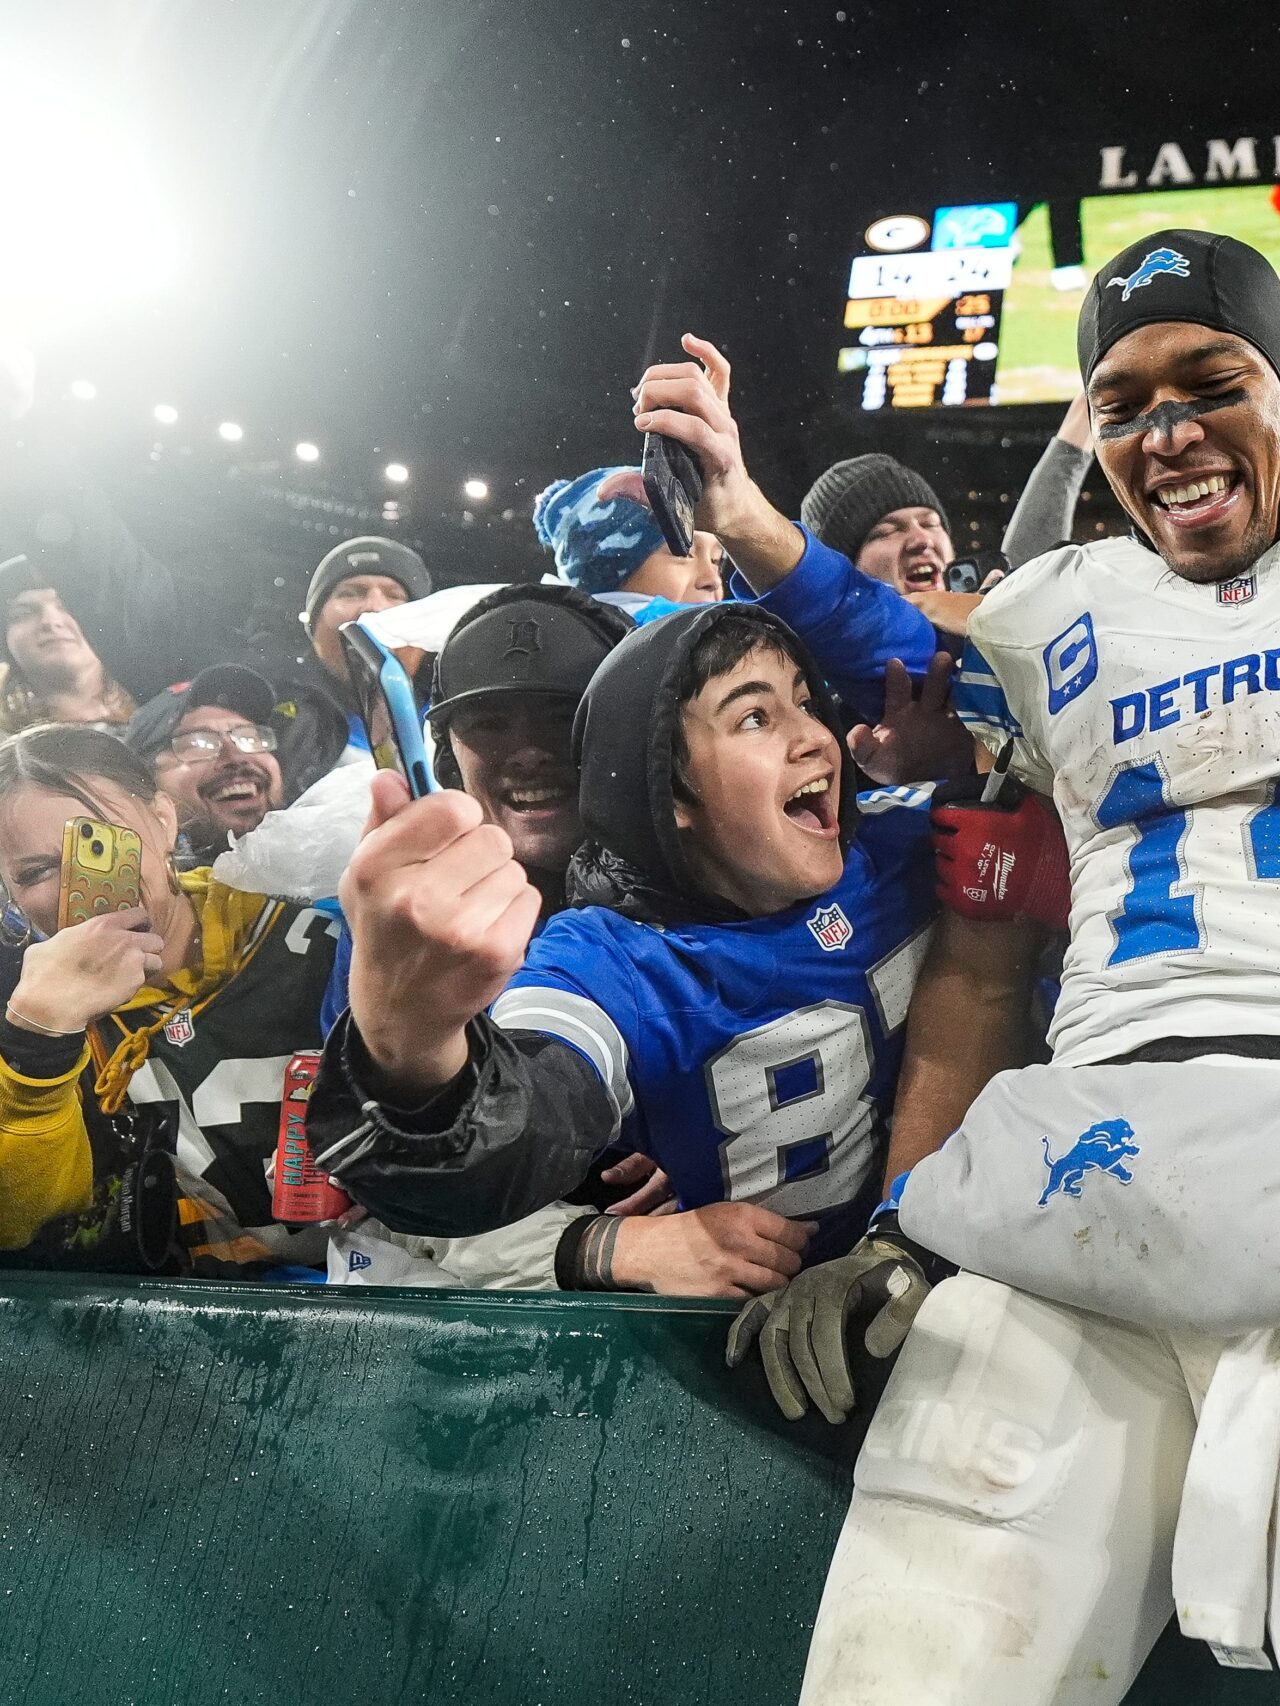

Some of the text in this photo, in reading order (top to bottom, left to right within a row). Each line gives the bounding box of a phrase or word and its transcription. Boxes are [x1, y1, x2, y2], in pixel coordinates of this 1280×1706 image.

[1049, 622, 1091, 691] C
[999, 851, 1016, 900] Milwaukee
[820, 921, 848, 945] NFL
[281, 1113, 306, 1187] HAPPY
